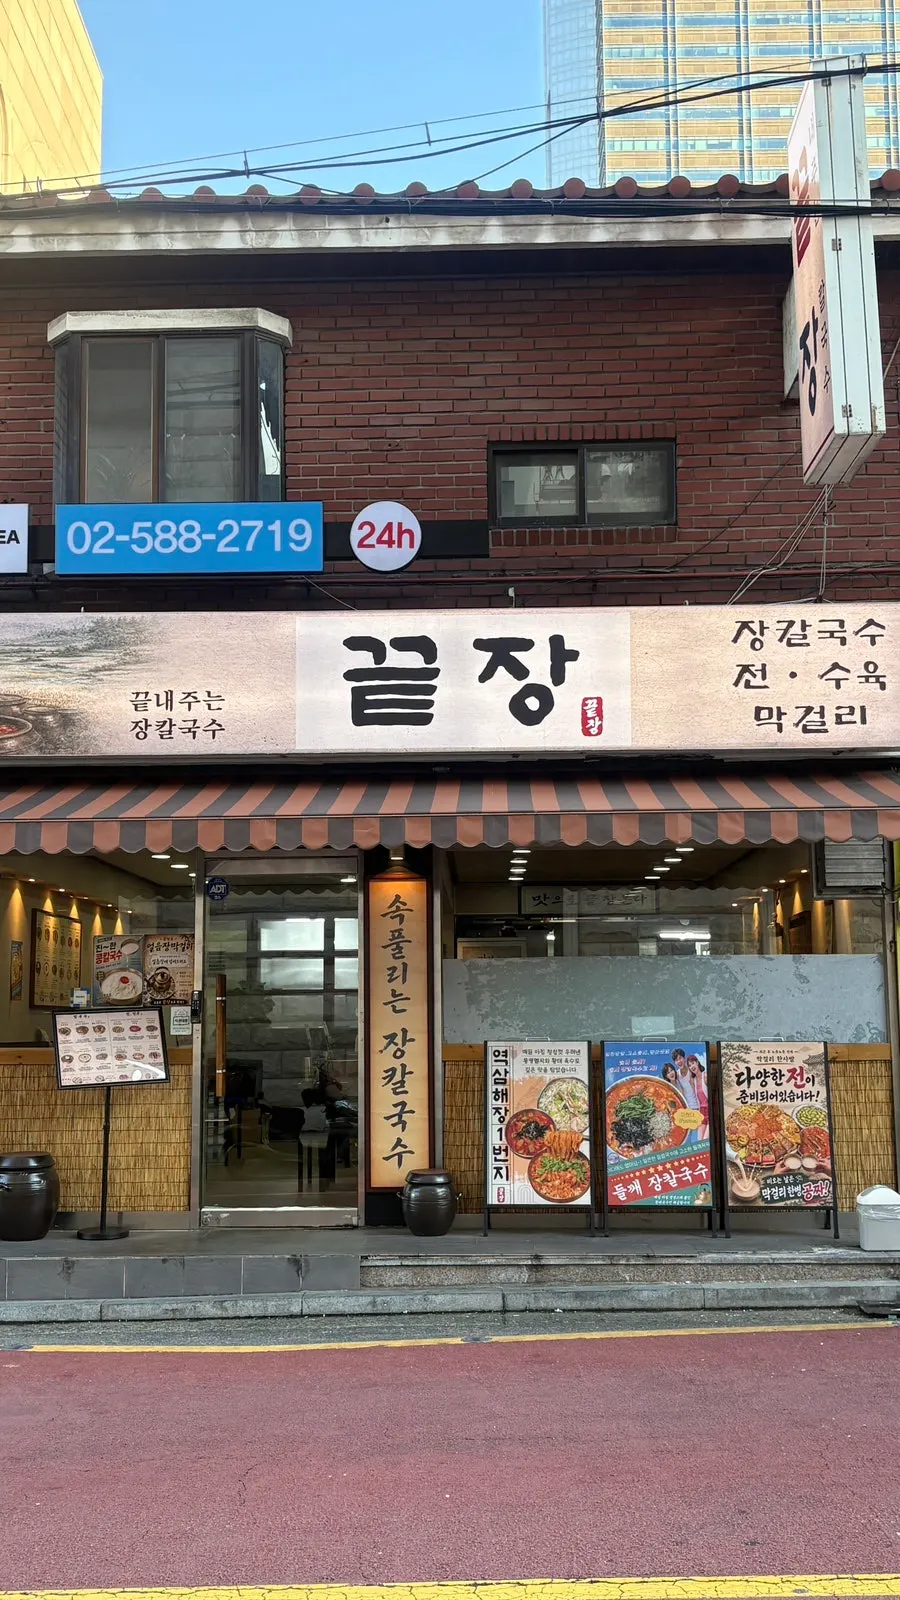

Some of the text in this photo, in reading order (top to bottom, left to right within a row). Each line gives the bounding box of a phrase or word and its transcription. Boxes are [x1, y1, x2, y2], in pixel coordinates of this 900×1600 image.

[66, 518, 313, 555] 02-588-2719
[356, 520, 416, 550] 24h
[731, 618, 888, 652] 장칼국수
[342, 634, 580, 727] 끝장
[732, 662, 770, 691] 전
[817, 660, 888, 692] 수육
[128, 689, 226, 713] 끝내주는
[584, 697, 603, 736] 끝장
[129, 717, 226, 742] 장칼국수
[753, 704, 868, 735] 막걸리
[209, 884, 227, 894] ADT
[380, 893, 416, 1170] 속풀리는 장칼국수
[736, 1065, 816, 1090] 다양한 전이
[735, 1088, 820, 1105] 준비되어있습니다!
[492, 1048, 510, 1183] 역삼해장1번지
[612, 1161, 709, 1201] 들깨 장칼국수
[761, 1181, 830, 1201] 막걸리 한병 공짜!
